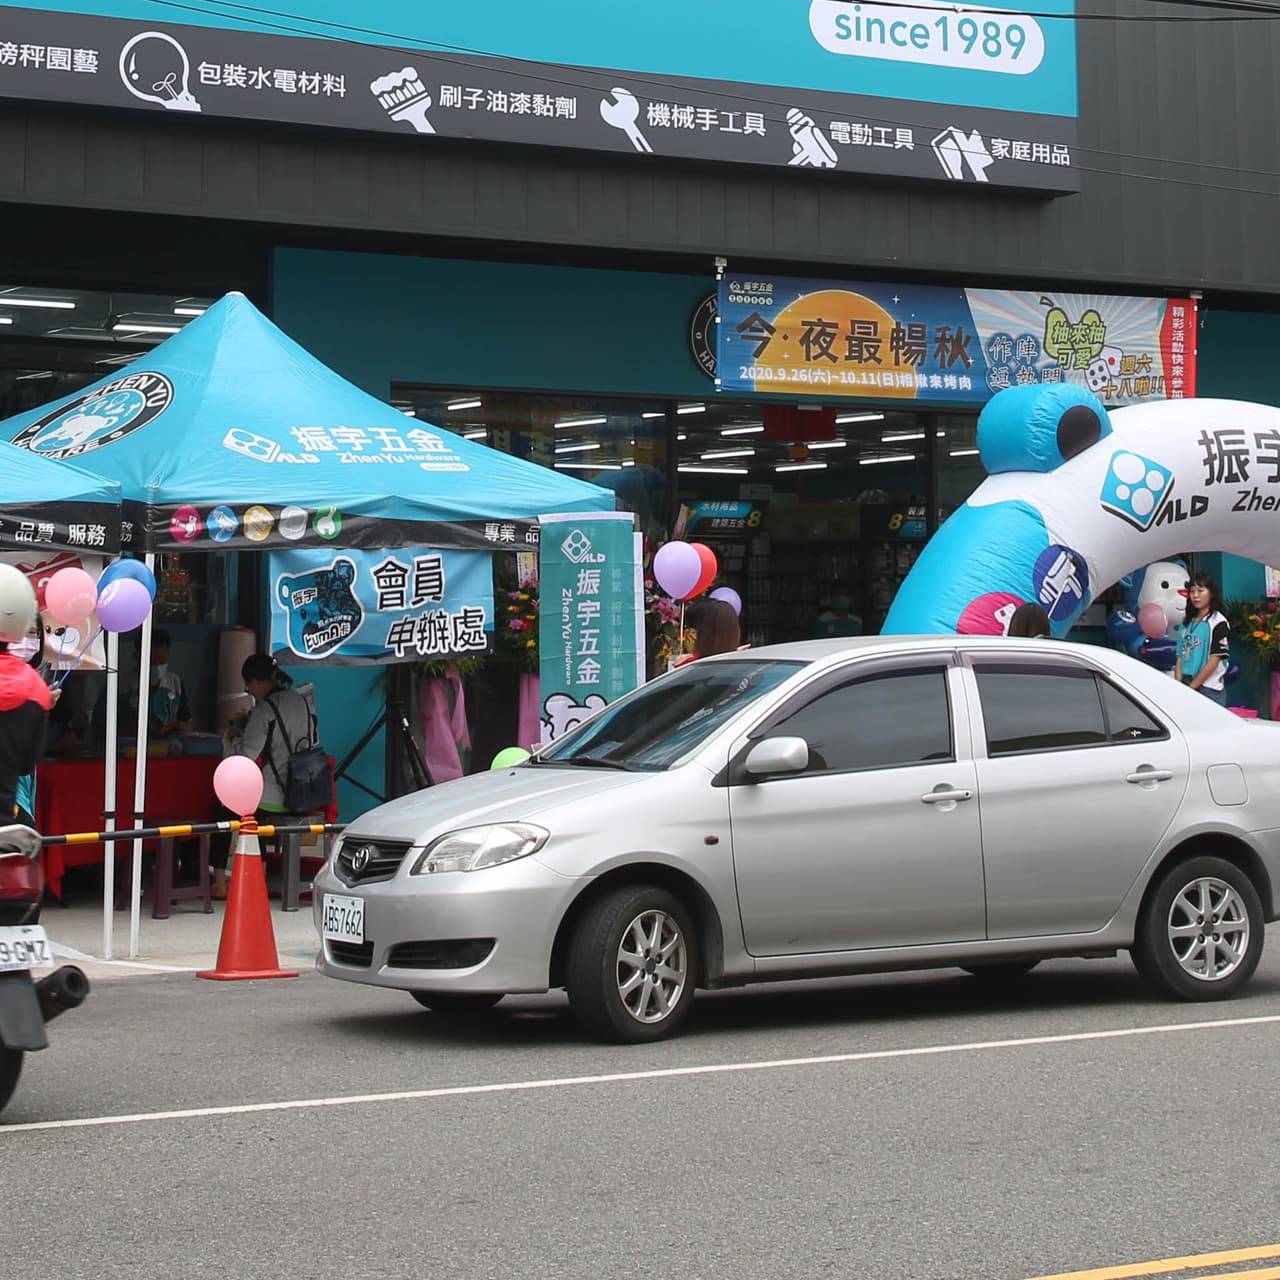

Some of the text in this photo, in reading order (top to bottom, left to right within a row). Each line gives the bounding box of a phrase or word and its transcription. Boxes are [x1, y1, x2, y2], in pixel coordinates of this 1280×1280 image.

[835, 5, 1027, 61] since1989
[197, 60, 347, 99] 包裝水電材料
[439, 83, 578, 120] 刷子油漆黏劑
[647, 102, 767, 138] 機械手工具
[829, 120, 915, 152] 電動工具
[991, 136, 1071, 168] 家庭用品
[290, 426, 453, 452] 振宇五金
[14, 521, 55, 544] 品質
[66, 523, 107, 546] 服務
[484, 522, 516, 543] 專業
[373, 555, 445, 610] 會員
[387, 607, 487, 656] 申辦處
[576, 568, 602, 685] 振宇五金
